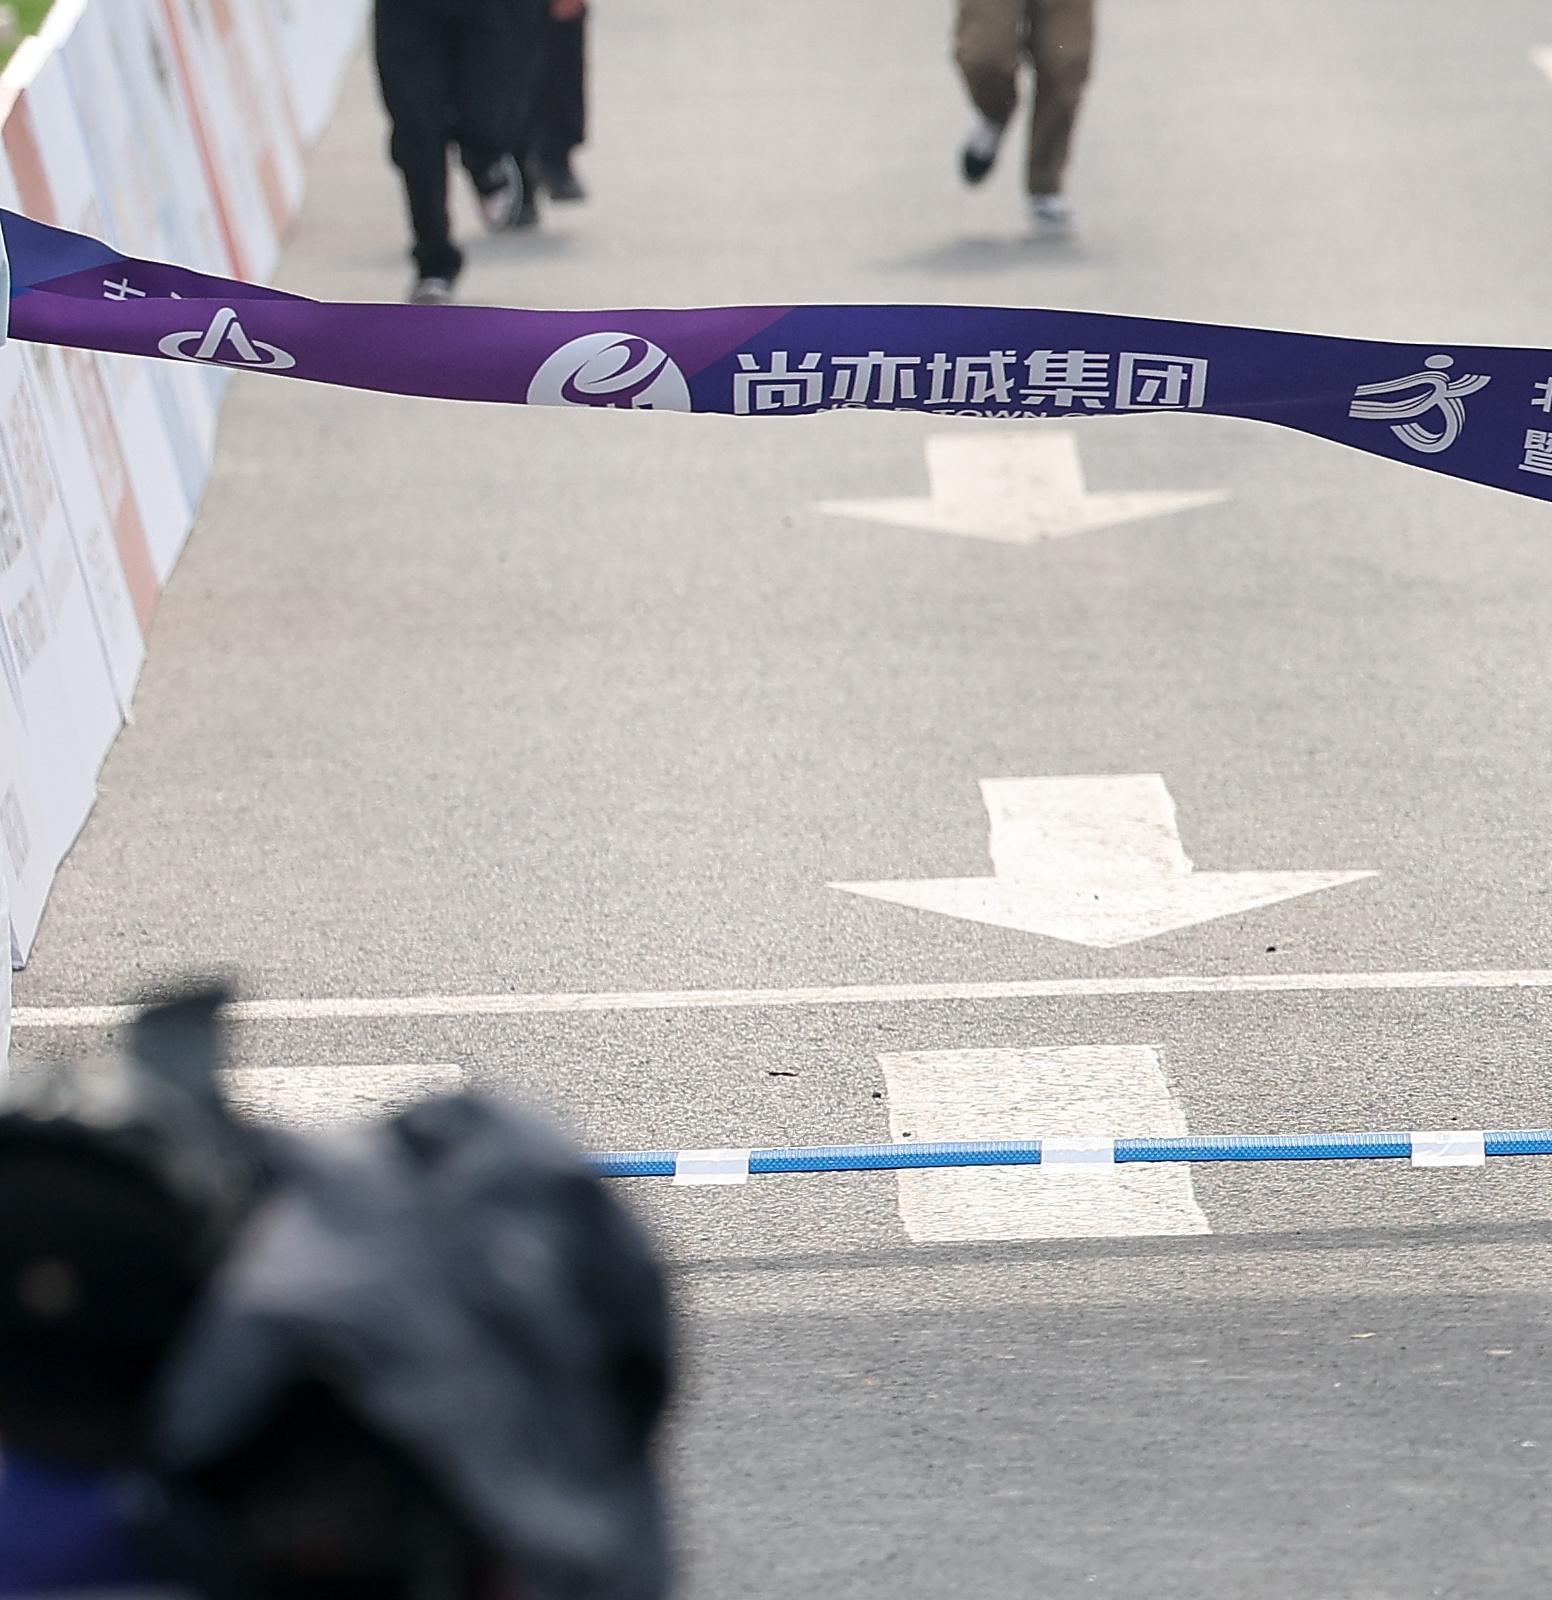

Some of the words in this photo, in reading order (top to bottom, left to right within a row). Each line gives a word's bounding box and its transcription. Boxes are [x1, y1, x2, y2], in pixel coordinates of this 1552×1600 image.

[732, 350, 1209, 415] 尚亦城集团
